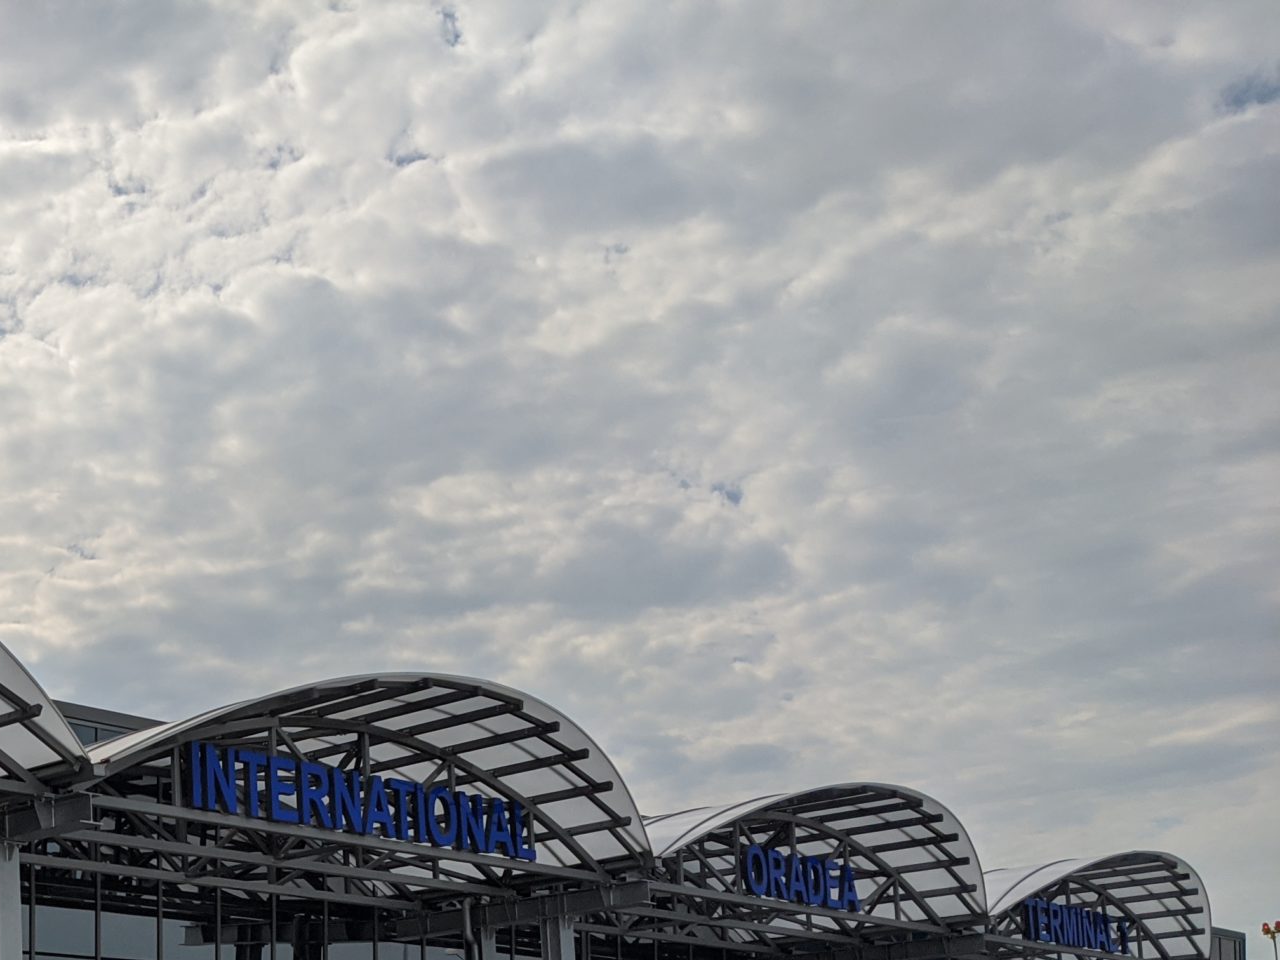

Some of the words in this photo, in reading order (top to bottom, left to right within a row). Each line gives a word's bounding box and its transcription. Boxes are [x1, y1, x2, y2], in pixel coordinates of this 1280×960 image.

[190, 740, 537, 862] INTERNATIONAL
[746, 843, 861, 912] ORADEA
[1024, 896, 1119, 953] TERMINAL
